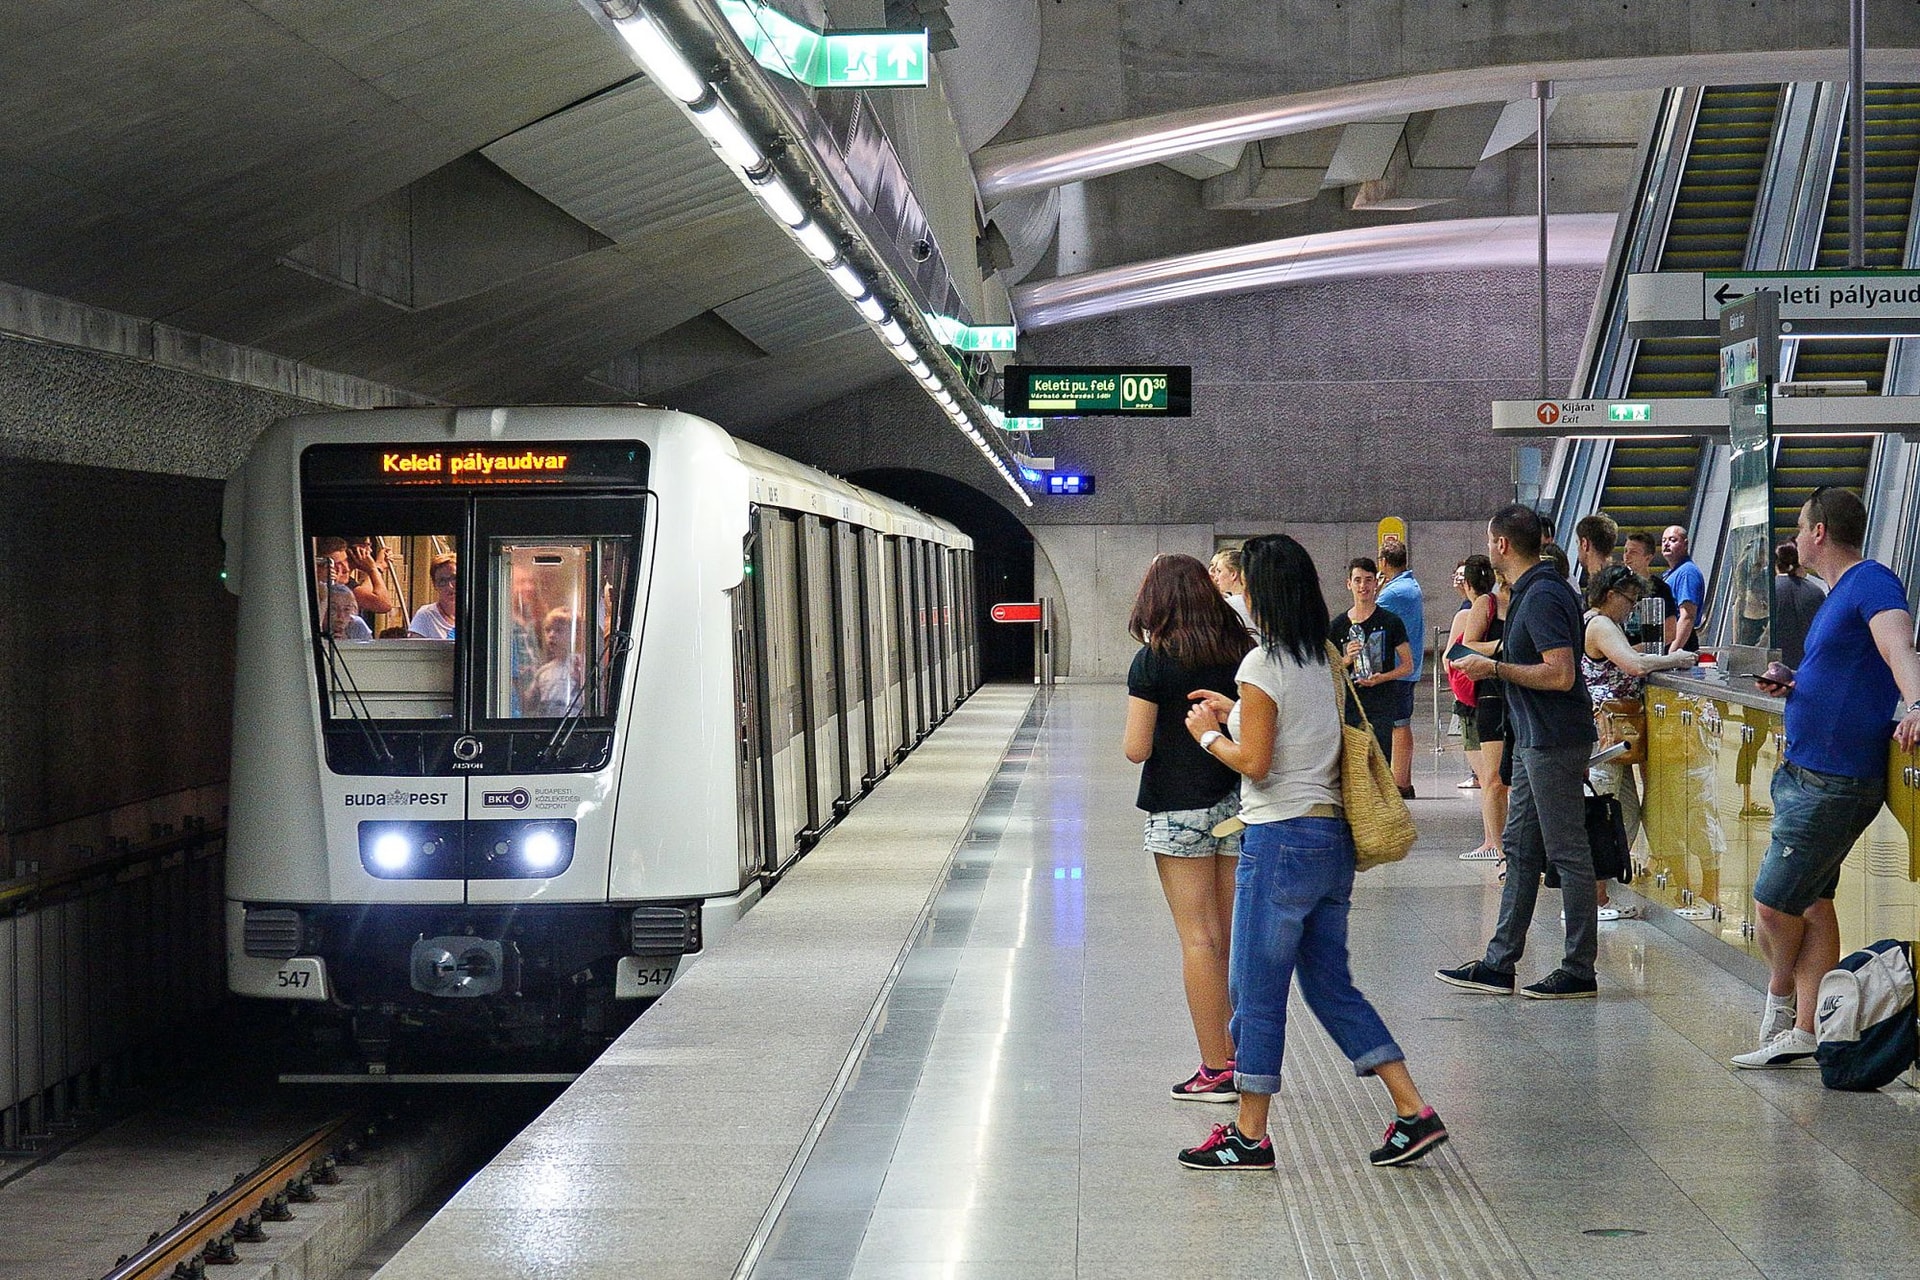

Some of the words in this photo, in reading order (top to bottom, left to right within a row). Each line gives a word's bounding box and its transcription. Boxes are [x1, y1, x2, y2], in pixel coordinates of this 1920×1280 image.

[1035, 379, 1070, 391] Keleti
[1072, 381, 1088, 393] pu.
[1090, 379, 1116, 391] felé
[1562, 403, 1595, 413] Kijárat
[1562, 415, 1579, 423] Exit
[383, 453, 441, 472] Keleti
[451, 452, 567, 475] pályaudvar
[488, 795, 509, 803] BKK
[278, 971, 310, 988] 547
[637, 967, 673, 986] 547
[1820, 995, 1844, 1012] NIKE
